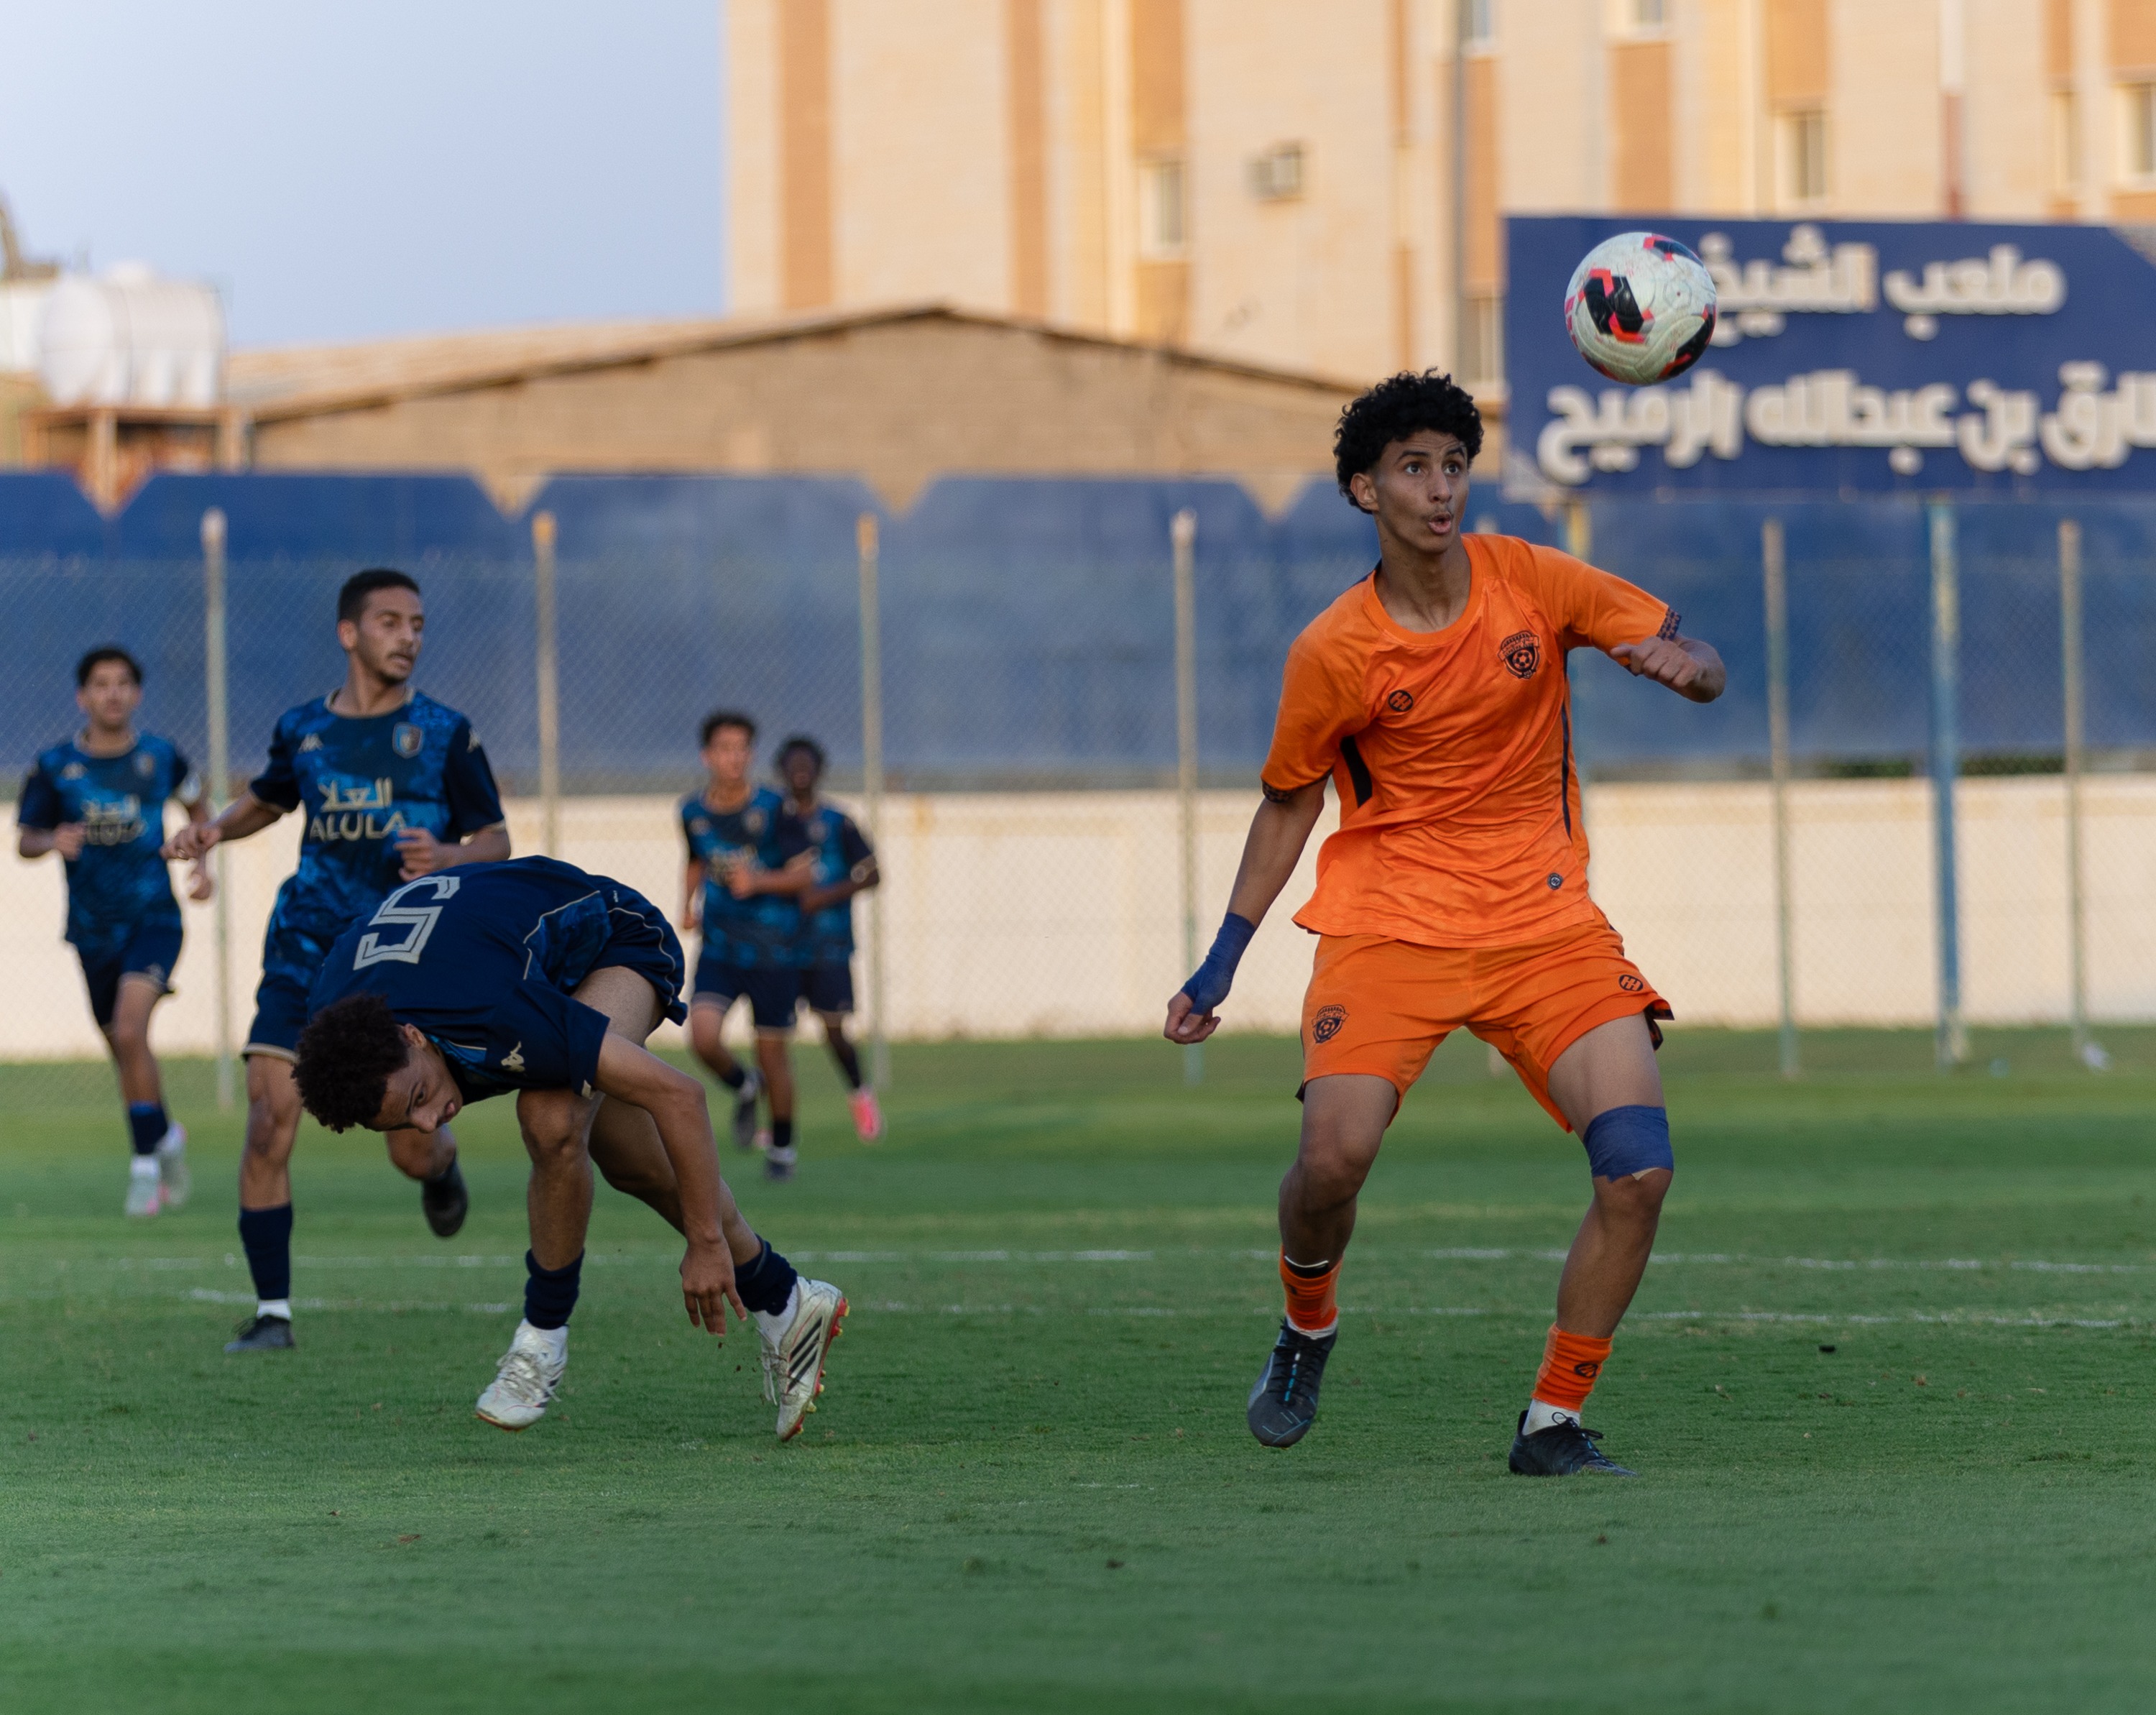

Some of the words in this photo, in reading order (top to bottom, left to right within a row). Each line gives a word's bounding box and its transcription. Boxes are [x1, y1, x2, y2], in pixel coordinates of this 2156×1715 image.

[1884, 242, 2066, 341] ملعب
[1537, 367, 1744, 486] الرميح
[1955, 376, 2042, 477] بن
[309, 811, 407, 842] ALULA
[318, 776, 393, 813] العلا
[353, 875, 461, 971] 5
